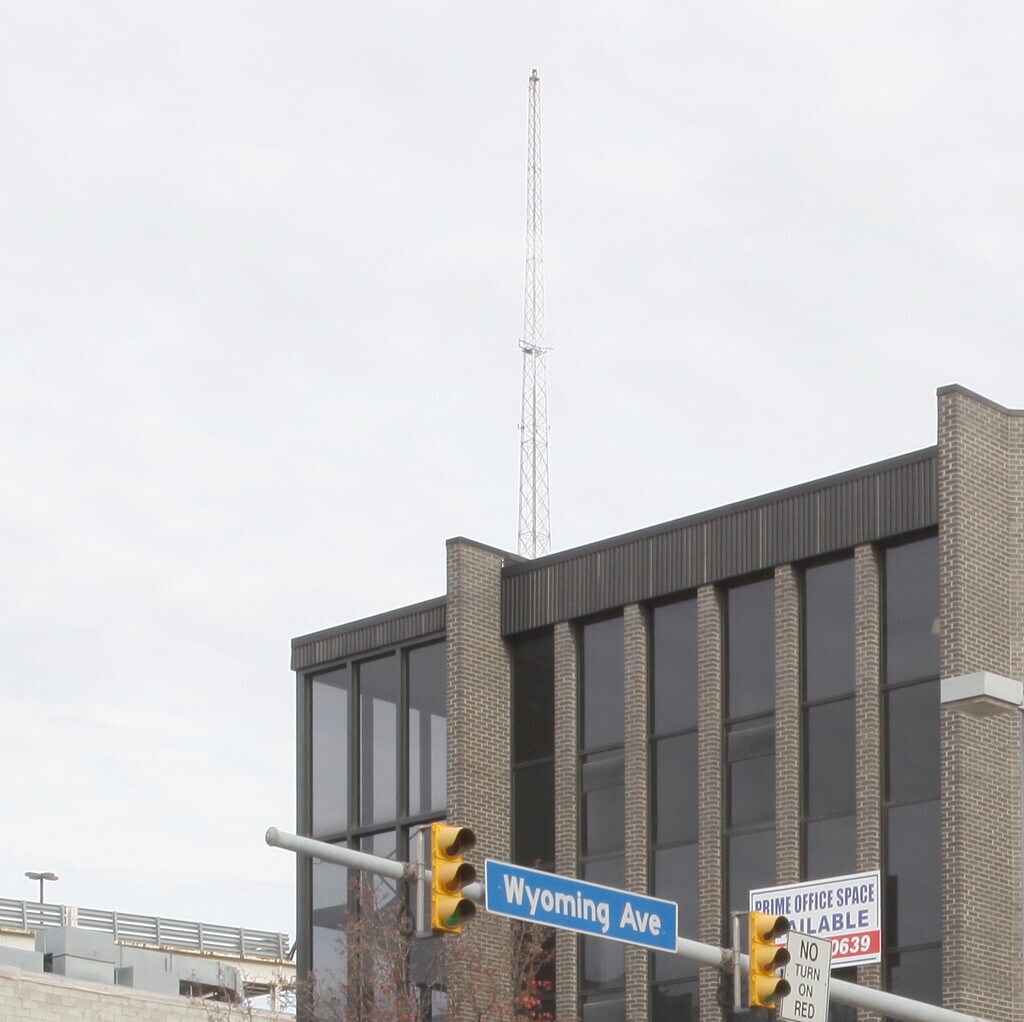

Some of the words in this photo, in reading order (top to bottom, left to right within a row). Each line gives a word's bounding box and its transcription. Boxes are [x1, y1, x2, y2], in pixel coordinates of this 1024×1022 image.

[503, 873, 610, 934] Wyoming
[619, 901, 662, 937] Ave
[754, 895, 791, 916] PRIME
[794, 889, 834, 914] OFFICE
[836, 883, 875, 908] SPACE
[788, 908, 869, 935] AILABLE
[799, 939, 819, 962] NO
[794, 962, 821, 982] TURN
[798, 983, 813, 999] ON
[794, 1000, 815, 1019] RED
